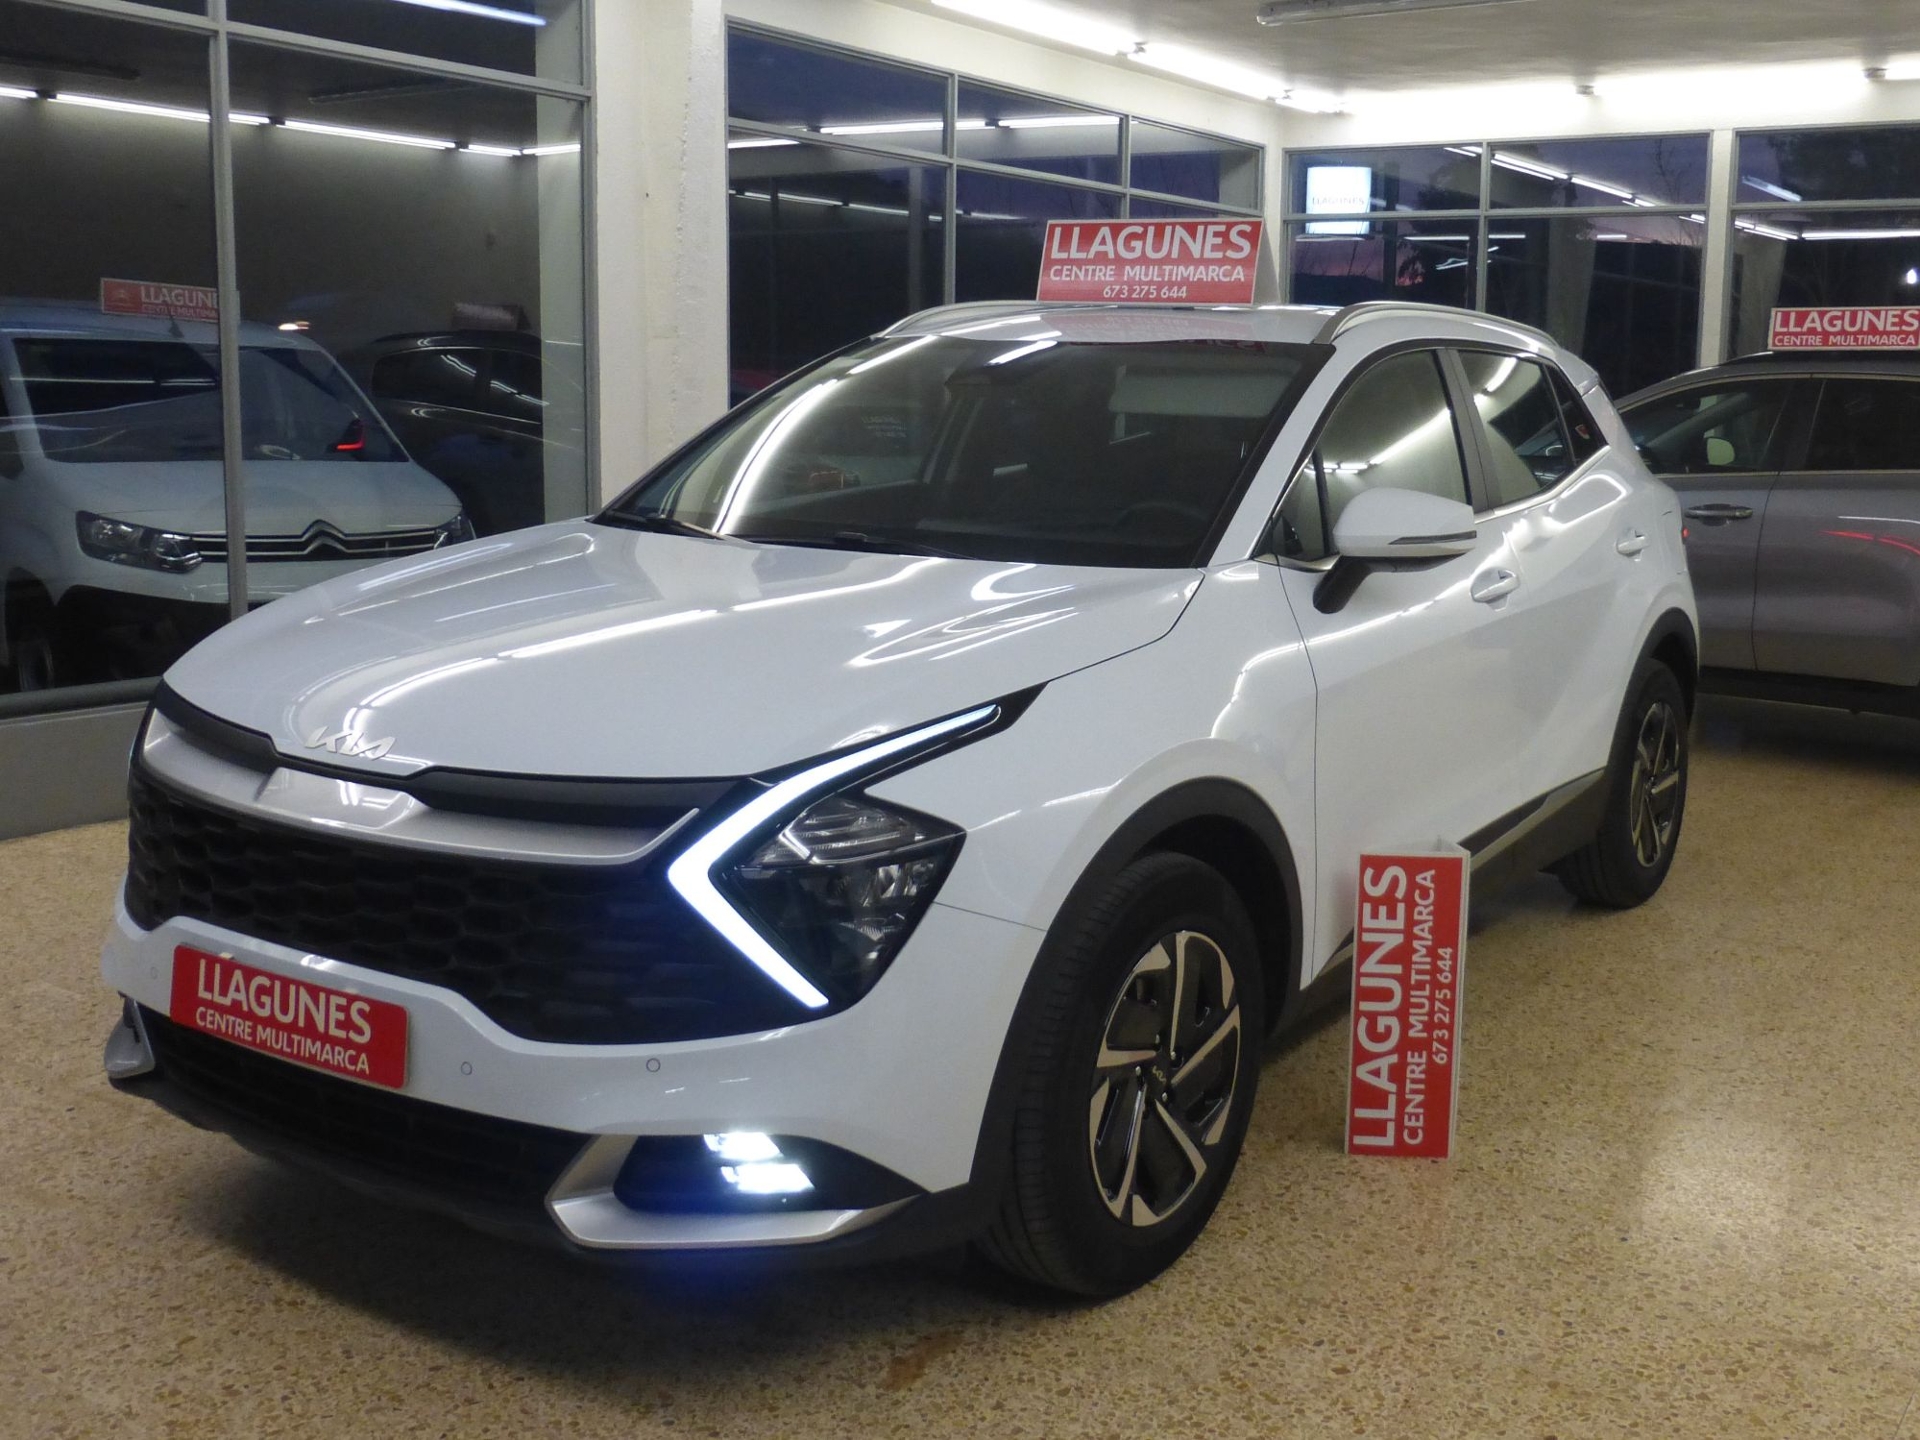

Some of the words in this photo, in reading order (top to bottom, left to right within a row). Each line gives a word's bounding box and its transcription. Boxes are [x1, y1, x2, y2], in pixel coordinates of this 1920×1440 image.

[1050, 224, 1253, 260] LLAGUNES
[1050, 265, 1115, 282] CENTRE
[1123, 265, 1245, 282] MULTIMARCA
[1103, 285, 1128, 299] 673
[1131, 285, 1157, 298] 275
[1160, 285, 1188, 299] 644
[1774, 309, 1920, 333] LLAGUNES
[1774, 335, 1823, 346] CENTRE
[1828, 334, 1916, 346] MULTIMARCA
[304, 725, 397, 761] KIA
[1408, 869, 1436, 1039] MULTIMARCA
[1437, 946, 1454, 982] 644
[197, 958, 372, 1045] LLAGUNES
[1353, 865, 1408, 1147] LLAGUNES
[1434, 988, 1451, 1024] 275
[195, 1006, 253, 1040] CENTRE
[256, 1026, 370, 1075] MULTIMARCA
[1432, 1029, 1449, 1065] 673
[1403, 1050, 1428, 1146] CENTRE
